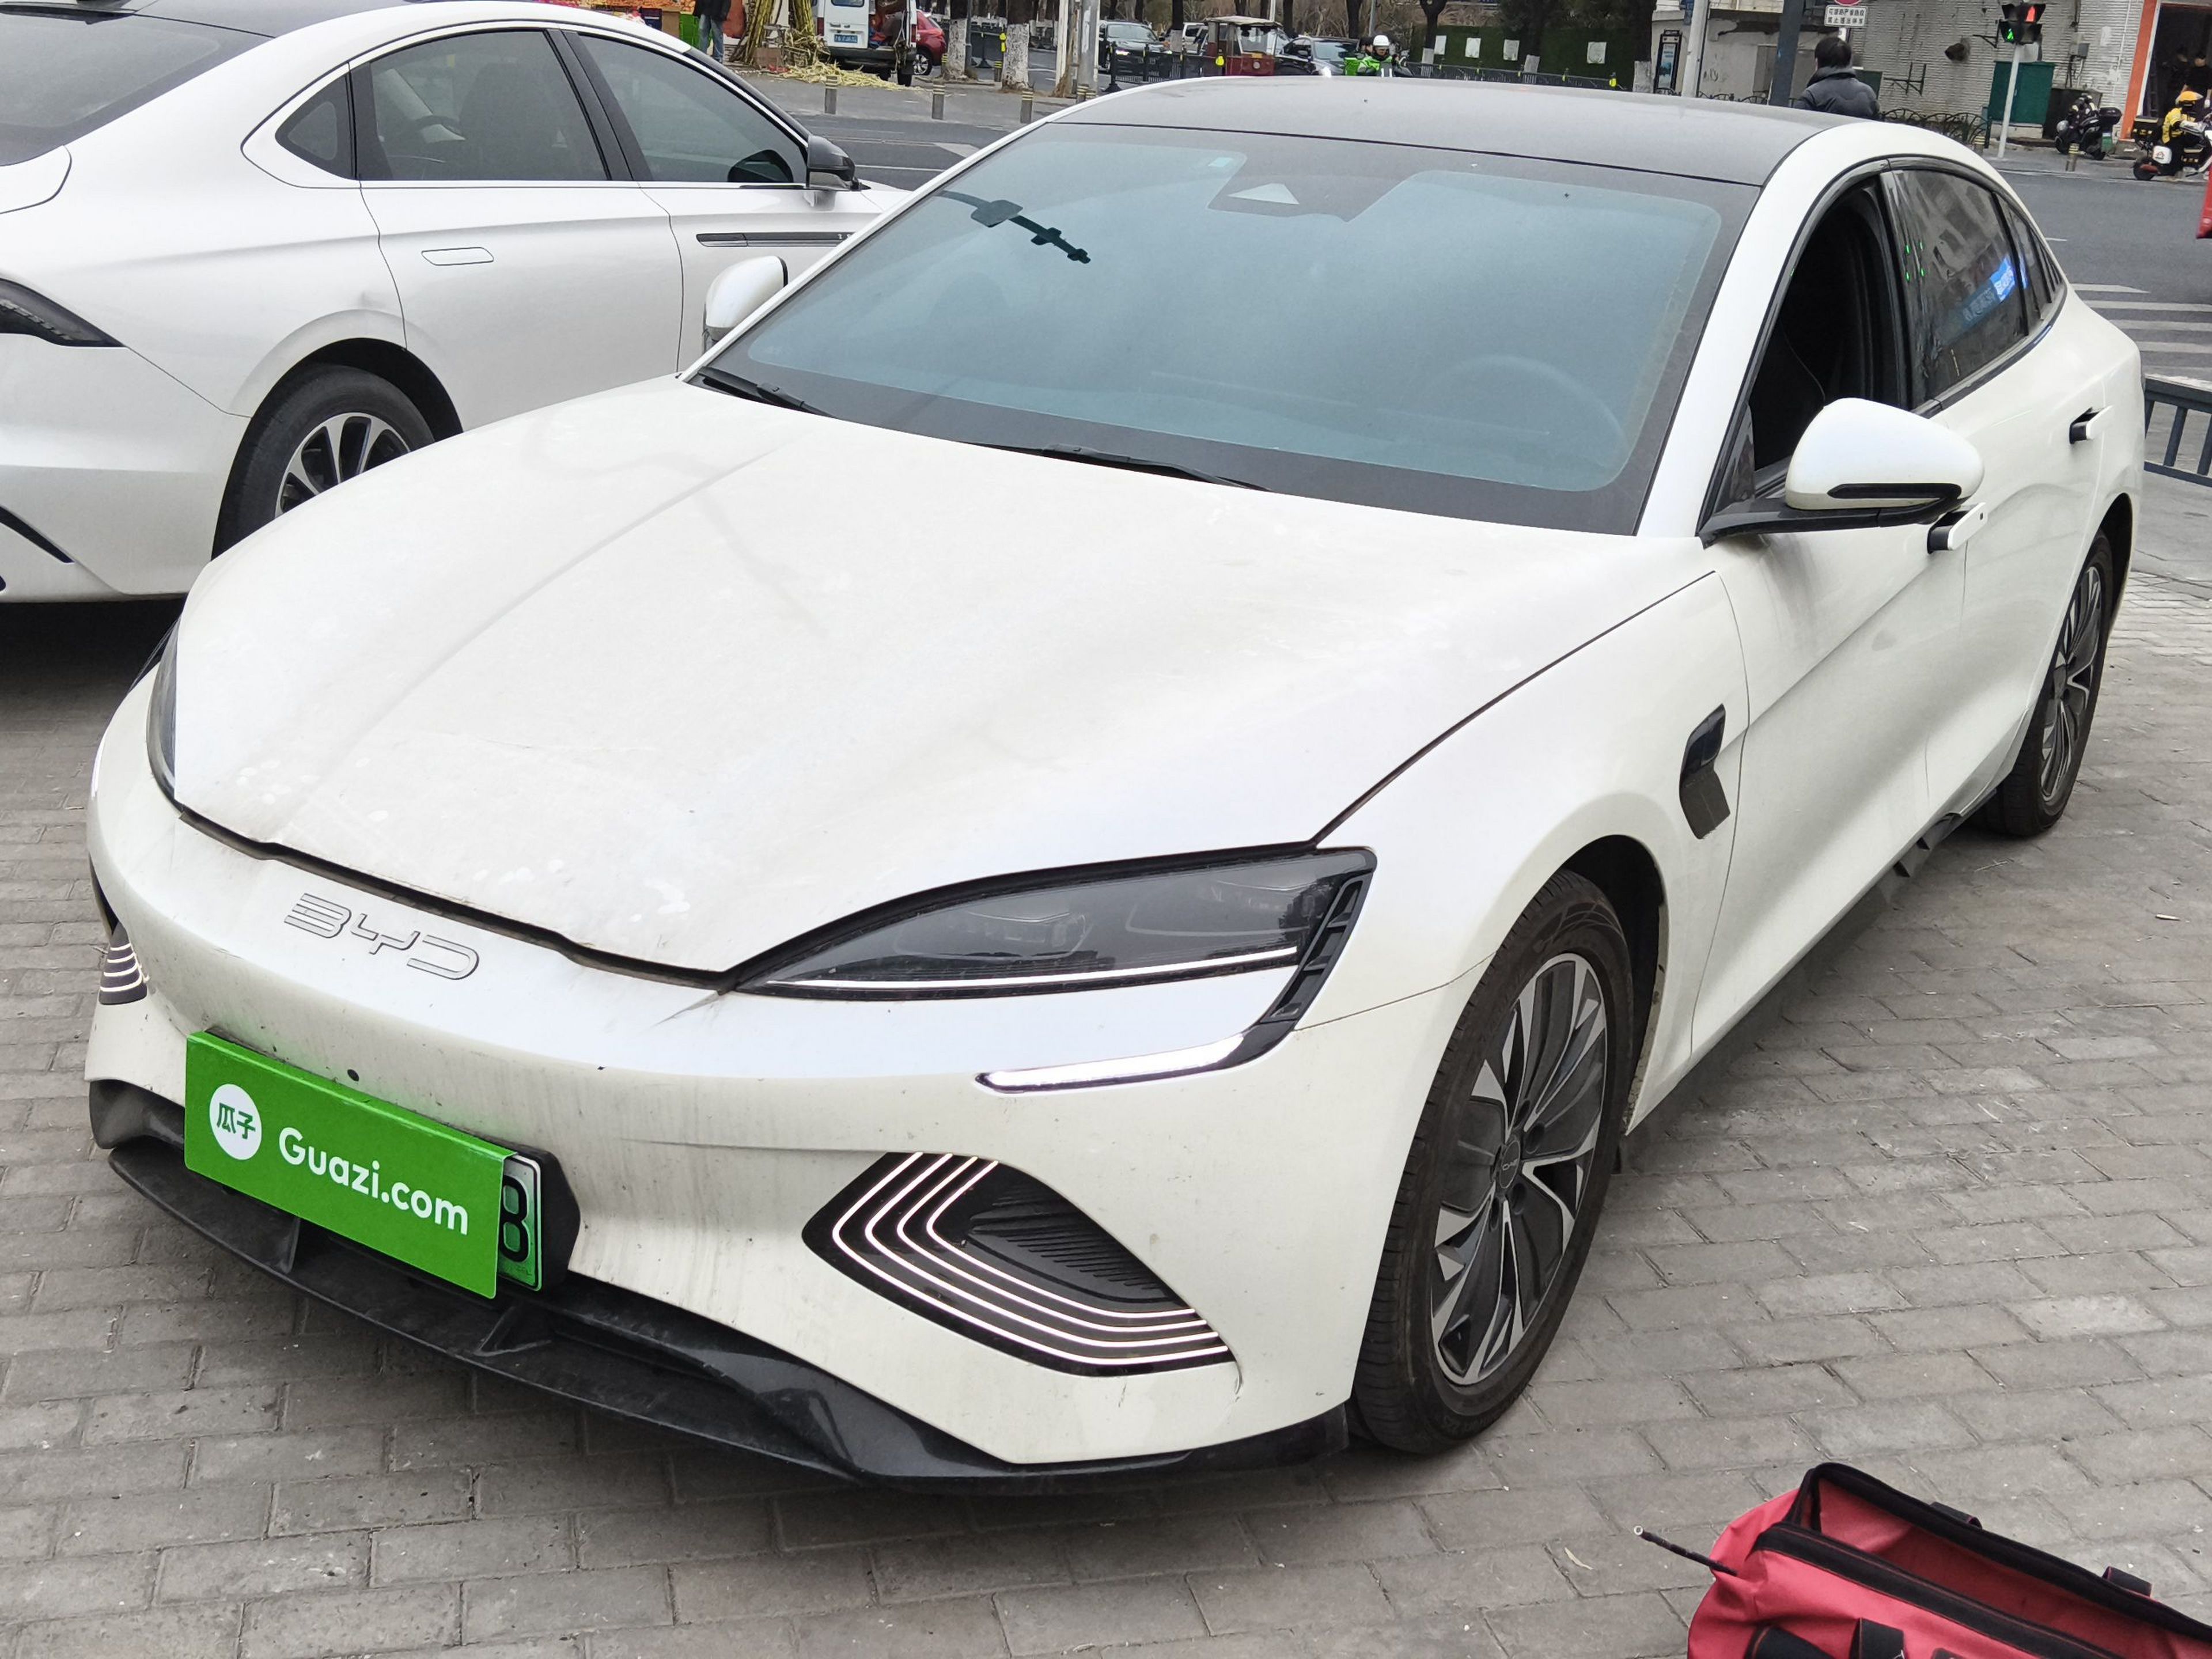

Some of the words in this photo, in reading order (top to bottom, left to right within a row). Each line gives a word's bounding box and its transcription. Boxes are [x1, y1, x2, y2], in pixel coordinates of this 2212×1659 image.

[284, 892, 479, 980] BYD
[216, 1102, 256, 1140] 瓜子
[279, 1126, 468, 1235] Guazi.com
